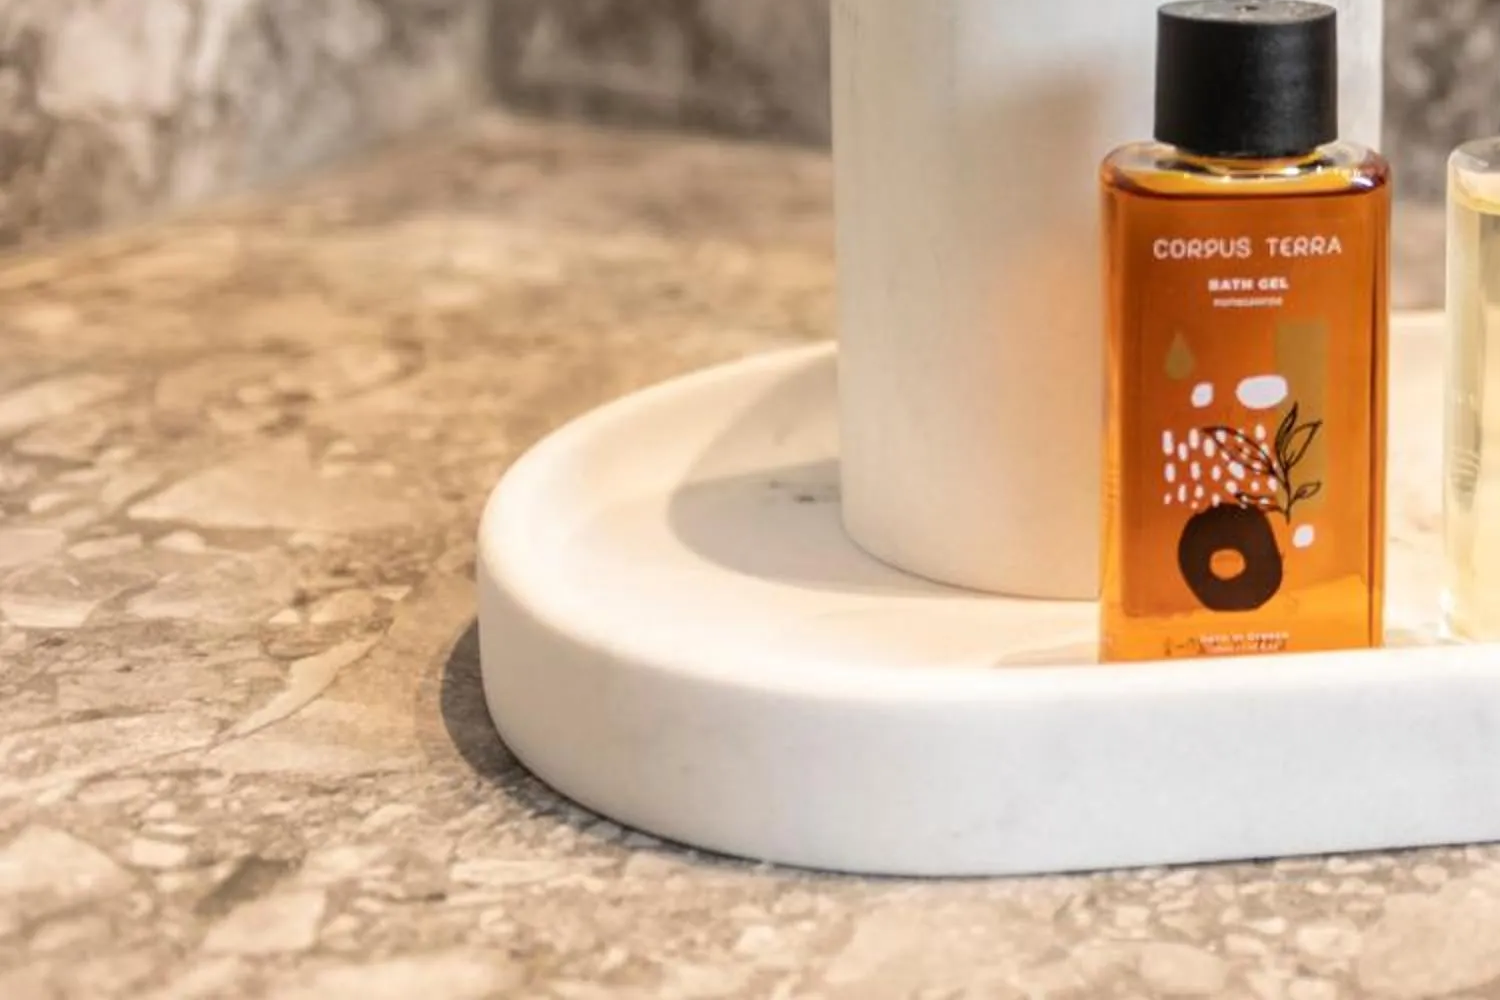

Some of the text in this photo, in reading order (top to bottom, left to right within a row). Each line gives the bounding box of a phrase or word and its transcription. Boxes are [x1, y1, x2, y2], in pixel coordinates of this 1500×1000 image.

[1152, 234, 1343, 259] CORPUS TERRA
[1208, 276, 1290, 292] BATH GEL
